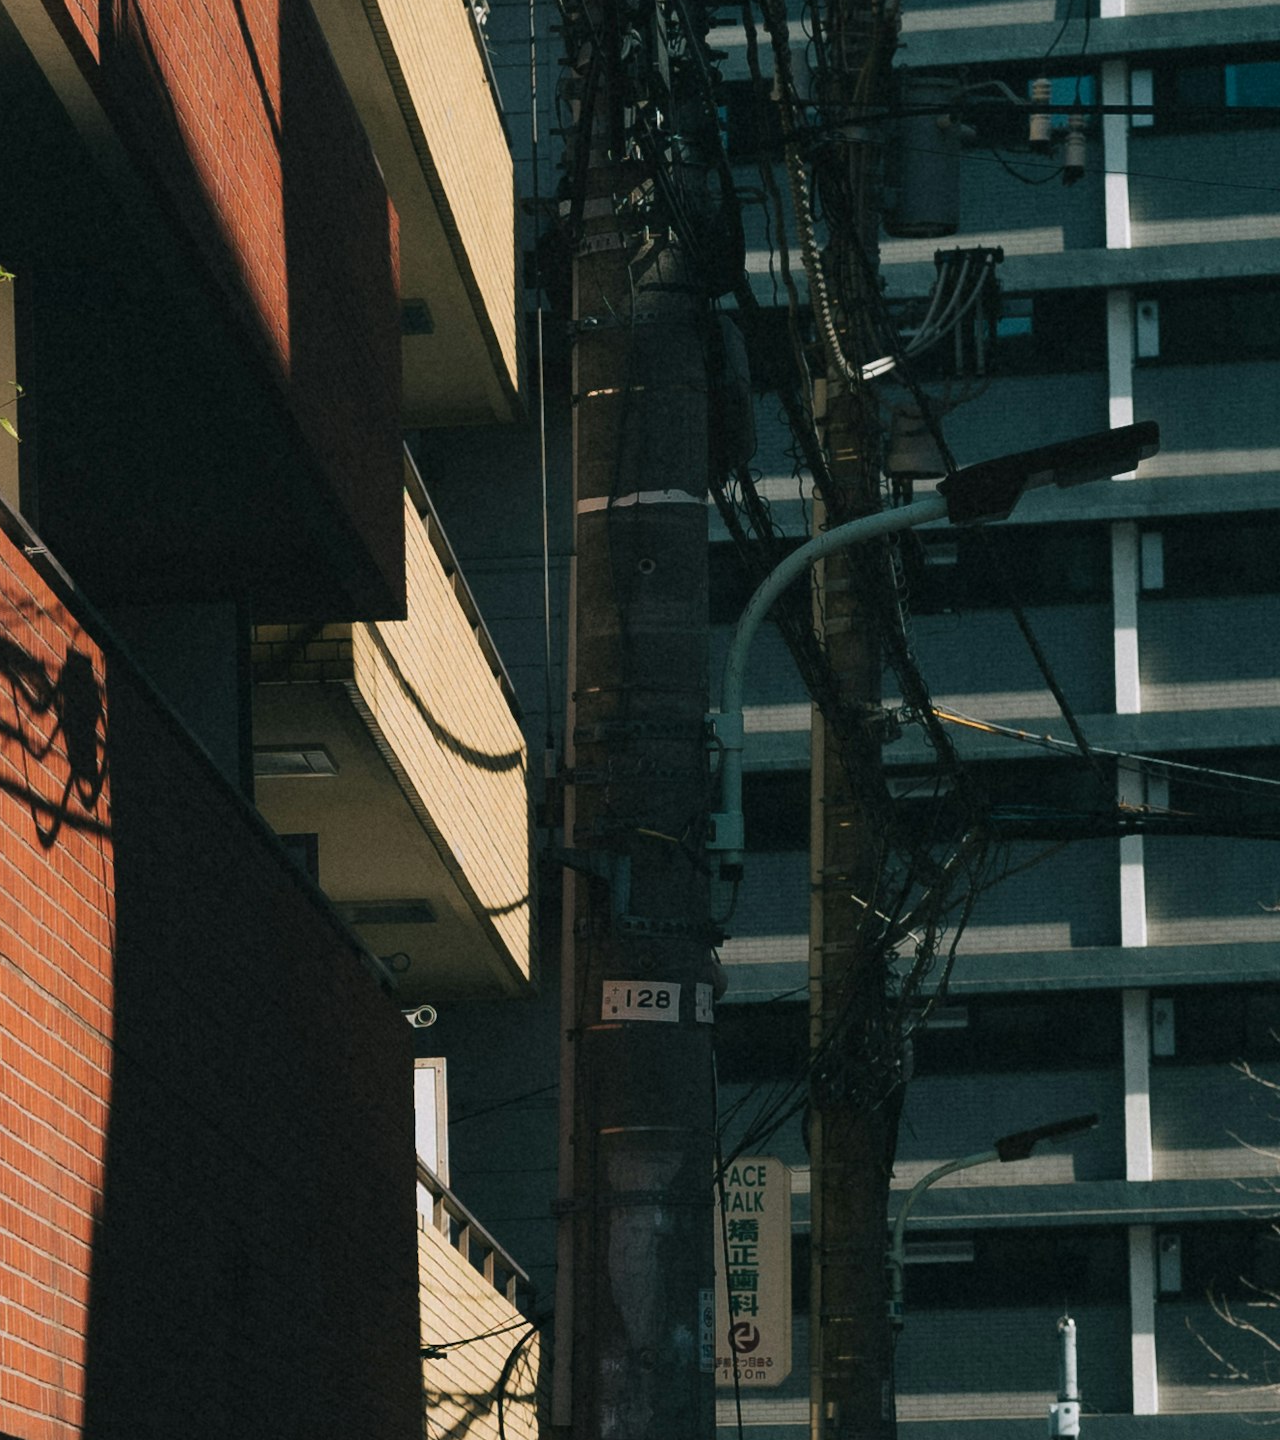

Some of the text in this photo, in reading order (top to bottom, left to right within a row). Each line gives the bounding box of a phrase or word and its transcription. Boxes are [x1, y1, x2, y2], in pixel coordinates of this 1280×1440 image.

[626, 988, 671, 1009] 128
[721, 1165, 767, 1187] ACE
[727, 1218, 759, 1317] 矯正歯科
